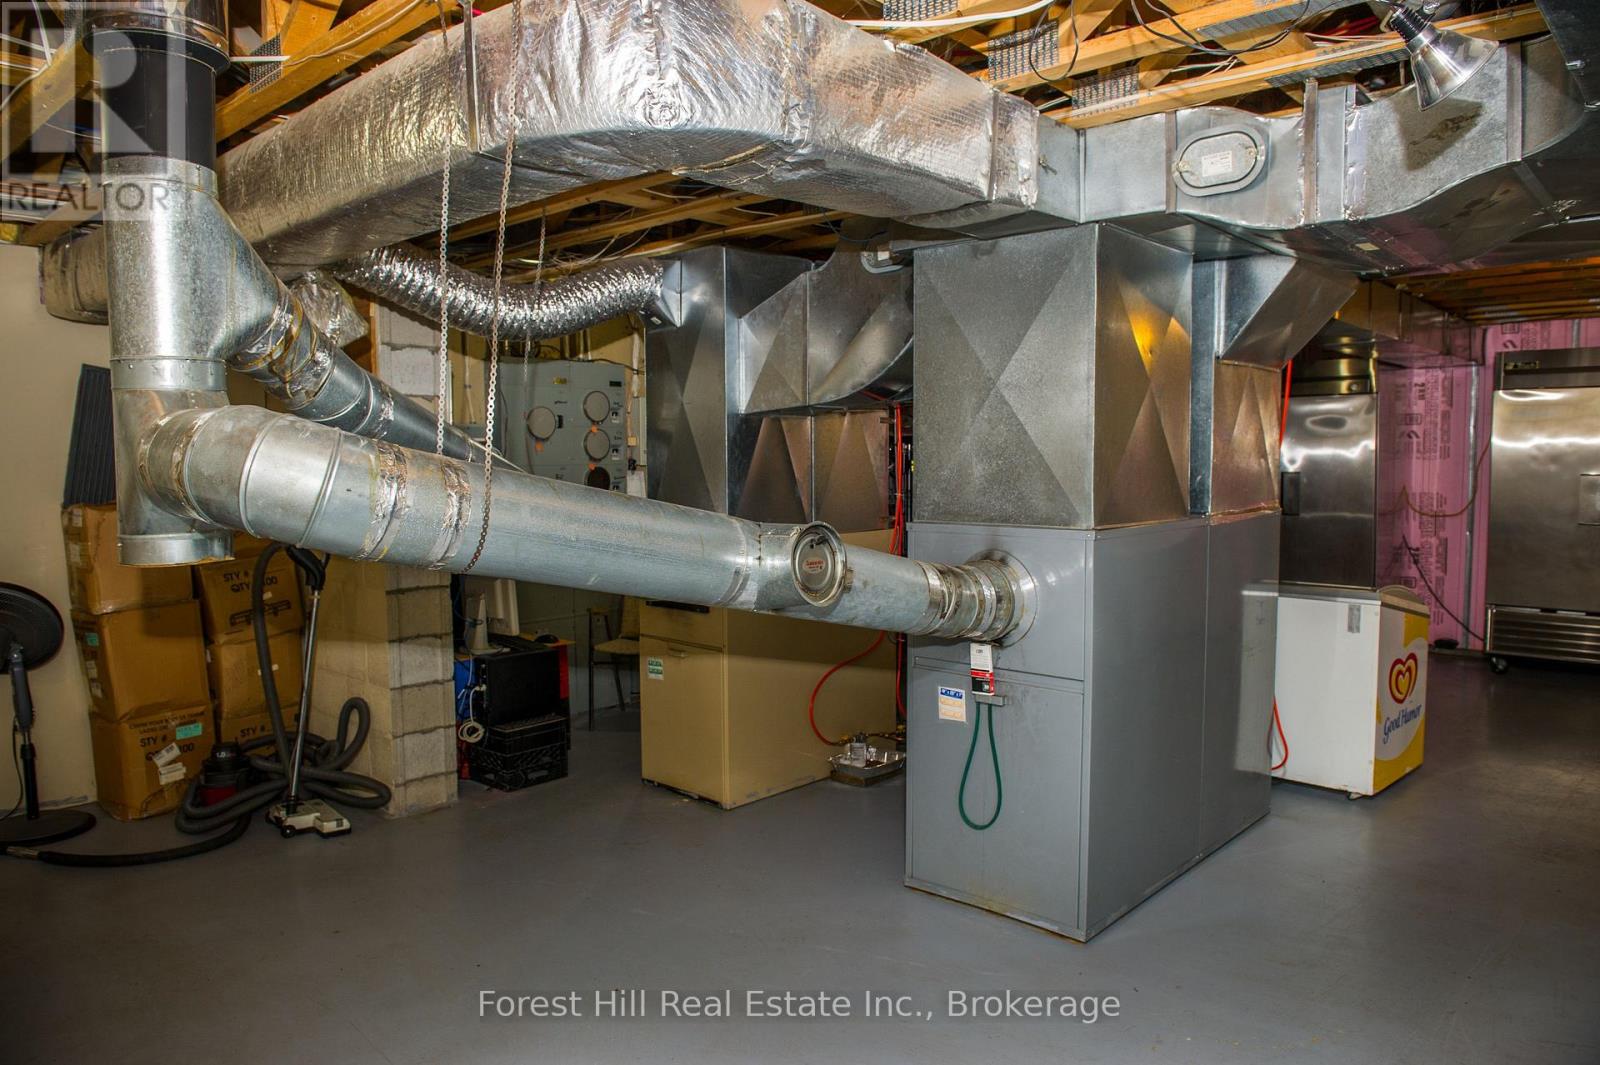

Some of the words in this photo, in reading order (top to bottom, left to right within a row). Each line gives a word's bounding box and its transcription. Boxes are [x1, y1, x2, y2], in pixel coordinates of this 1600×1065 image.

[224, 571, 240, 582] STY
[1383, 710, 1402, 745] Good
[1401, 704, 1422, 727] Humor
[240, 726, 257, 737] STY
[140, 735, 158, 748] STY
